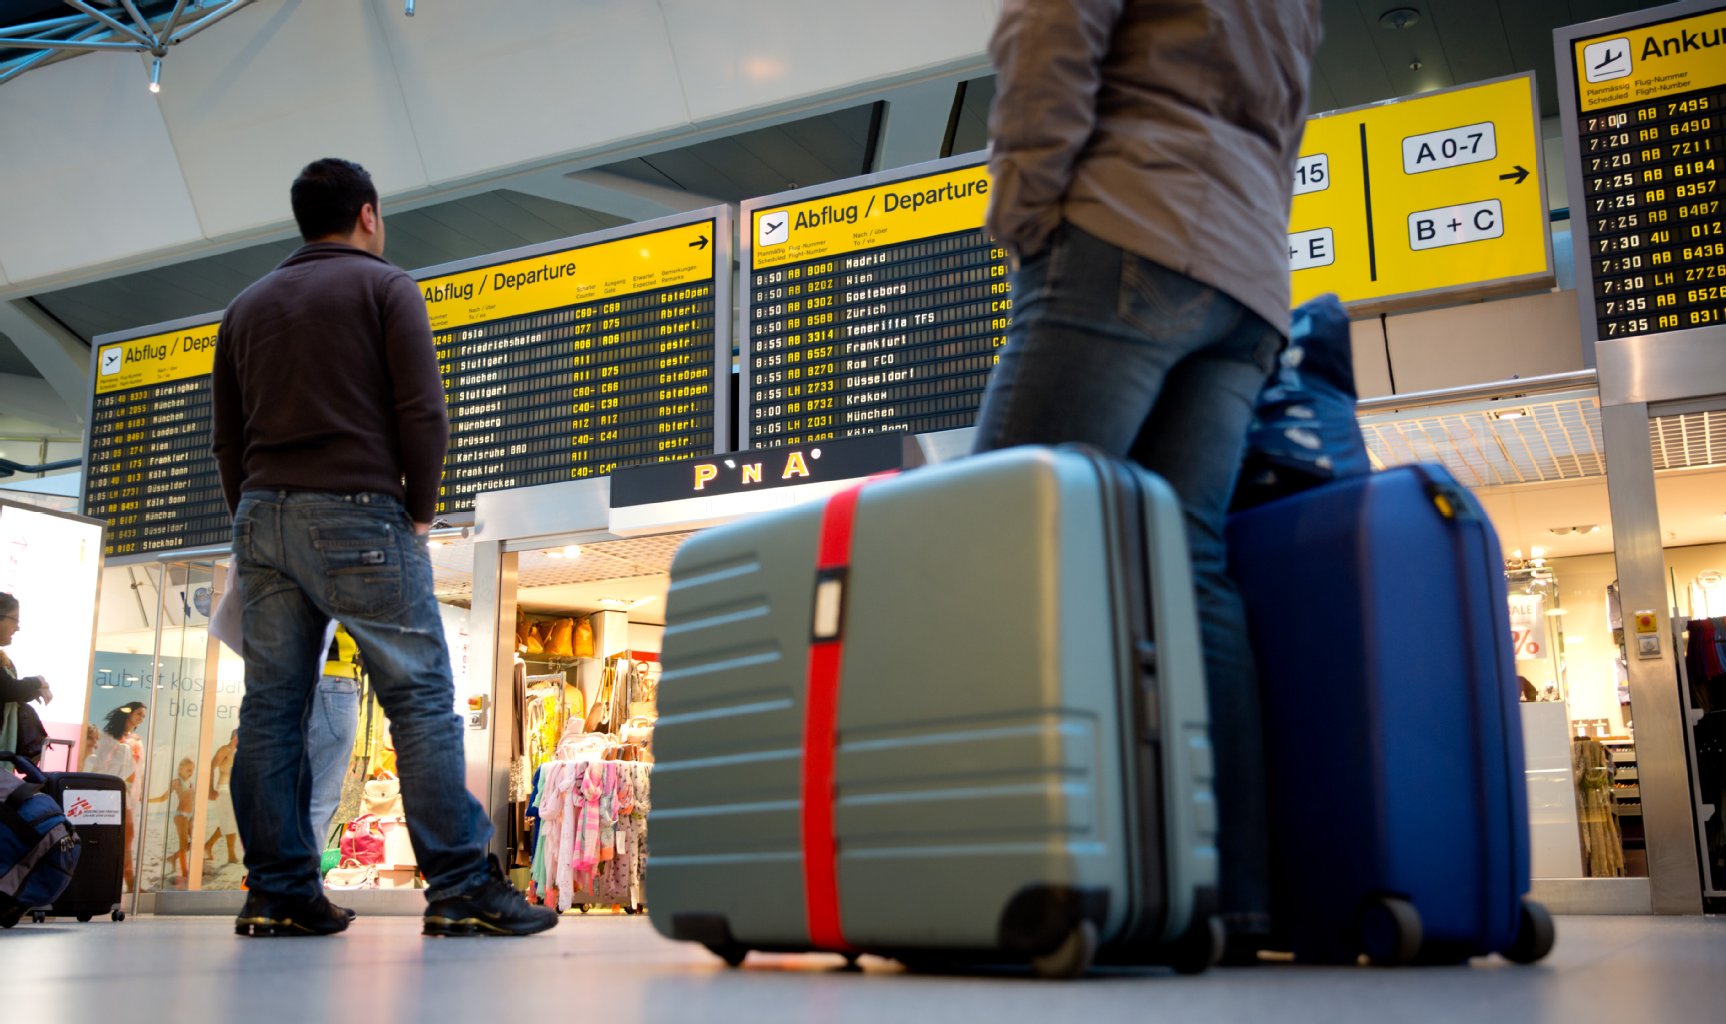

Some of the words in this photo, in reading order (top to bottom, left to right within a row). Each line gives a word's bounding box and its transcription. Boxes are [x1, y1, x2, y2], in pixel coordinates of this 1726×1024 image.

[1588, 92, 1629, 105] Scheduled
[1636, 80, 1691, 96] Flight-Number
[1635, 71, 1688, 86] Flug-Nummer
[1588, 113, 1627, 131] 7:00
[1638, 108, 1656, 120] AB
[1668, 98, 1708, 115] 7495
[1416, 142, 1436, 164] A
[1442, 132, 1483, 159] 0-7
[1590, 133, 1629, 150] 7:20
[1640, 128, 1658, 141] AB
[1670, 118, 1710, 135] 6490
[1592, 153, 1630, 170] 7:20
[1642, 148, 1660, 161] AB
[1672, 139, 1710, 156] 7211
[1594, 174, 1633, 190] 7:25
[1644, 169, 1662, 182] AB
[1674, 159, 1715, 176] 6184
[794, 205, 857, 231] Abflug
[864, 195, 876, 218] /
[884, 178, 988, 213] Departure
[1596, 194, 1635, 211] 7:25
[1646, 189, 1665, 202] AB
[1677, 180, 1716, 197] 8357
[1416, 219, 1436, 241] B
[1447, 218, 1462, 232] +
[1473, 209, 1494, 230] C
[1599, 215, 1637, 231] 7:25
[1648, 210, 1667, 223] AB
[1679, 201, 1719, 217] 8487
[789, 240, 826, 251] Flug-Nummer
[1309, 237, 1325, 258] E
[1600, 235, 1639, 252] 7:30
[1651, 231, 1669, 243] 4U
[1692, 222, 1721, 237] 012
[757, 255, 786, 265] Scheduled
[789, 247, 828, 259] Flight-Number
[757, 272, 781, 285] 8:50
[788, 269, 800, 278] AB
[808, 262, 832, 275] 8080
[846, 252, 886, 268] Madrid
[1602, 256, 1641, 272] 7:30
[1652, 251, 1671, 264] AB
[1683, 244, 1724, 260] 6436
[425, 283, 473, 303] Abflug
[478, 274, 488, 295] /
[494, 263, 576, 290] Departure
[757, 289, 782, 301] 8:50
[788, 285, 800, 295] AB
[808, 279, 833, 292] 8202
[846, 273, 872, 285] Wien
[1604, 277, 1643, 293] 7:30
[1655, 272, 1673, 286] LH
[1686, 265, 1726, 281] 2726
[462, 329, 483, 341] Oslo
[661, 287, 708, 303] GateOpen
[756, 305, 781, 318] 8:50
[788, 302, 800, 312] AB
[807, 296, 833, 309] 8302
[846, 284, 906, 302] Goeteborg
[1607, 298, 1646, 314] 7:35
[1657, 294, 1676, 306] AB
[462, 334, 541, 356] Friedrichshafen
[661, 304, 699, 319] Abfert.
[756, 322, 781, 334] 8:50
[788, 319, 800, 329] AB
[846, 304, 886, 319] Zürich
[756, 338, 781, 351] 8:55
[788, 335, 800, 346] AB
[808, 329, 833, 342] 3314
[847, 318, 907, 336] Teneriffa
[915, 312, 934, 325] TFS
[1609, 319, 1648, 335] 7:35
[1659, 315, 1678, 328] AB
[125, 345, 166, 363] Abflug
[461, 354, 507, 370] Stuttgart
[661, 320, 699, 336] Abfert.
[756, 355, 781, 368] 8:55
[788, 352, 800, 363] AB
[846, 335, 906, 353] Frankfurt
[460, 372, 497, 385] München
[574, 355, 589, 366] A11
[660, 338, 693, 352] gestr.
[756, 372, 781, 384] 8:55
[788, 369, 800, 379] AB
[874, 354, 894, 366] FCO
[459, 401, 500, 416] Budapest
[660, 368, 708, 384] GateOpen
[460, 385, 507, 401] Stuttgart
[574, 370, 589, 382] A11
[660, 355, 693, 368] gestr.
[756, 388, 781, 401] 8:55
[788, 385, 800, 396] LH
[808, 380, 834, 393] 2733
[847, 368, 914, 388] Düsseldorf
[459, 418, 501, 432] Nürnberg
[660, 384, 708, 400] GateOpen
[756, 405, 781, 418] 9:00
[788, 402, 800, 413] AB
[807, 398, 833, 411] 8732
[846, 391, 887, 405] Krakow
[458, 433, 494, 447] Brüssel
[572, 418, 589, 429] A12
[601, 414, 617, 425] A12
[659, 402, 698, 416] Abfert.
[756, 422, 781, 435] 9:05
[788, 420, 800, 430] LH
[808, 415, 832, 428] 2031
[847, 408, 894, 422] München
[457, 448, 505, 462] Karlsruhe
[601, 430, 617, 441] C44
[659, 418, 698, 433] Abfert.
[457, 463, 504, 478] Frankfurt
[572, 450, 587, 462] A11
[659, 437, 692, 450] gestr.
[456, 478, 514, 494] Saarbrücken
[455, 499, 476, 509] Wars
[1512, 605, 1533, 615] ALE
[96, 668, 134, 688] aub
[171, 672, 243, 694] kosar
[169, 698, 239, 718] bleen
